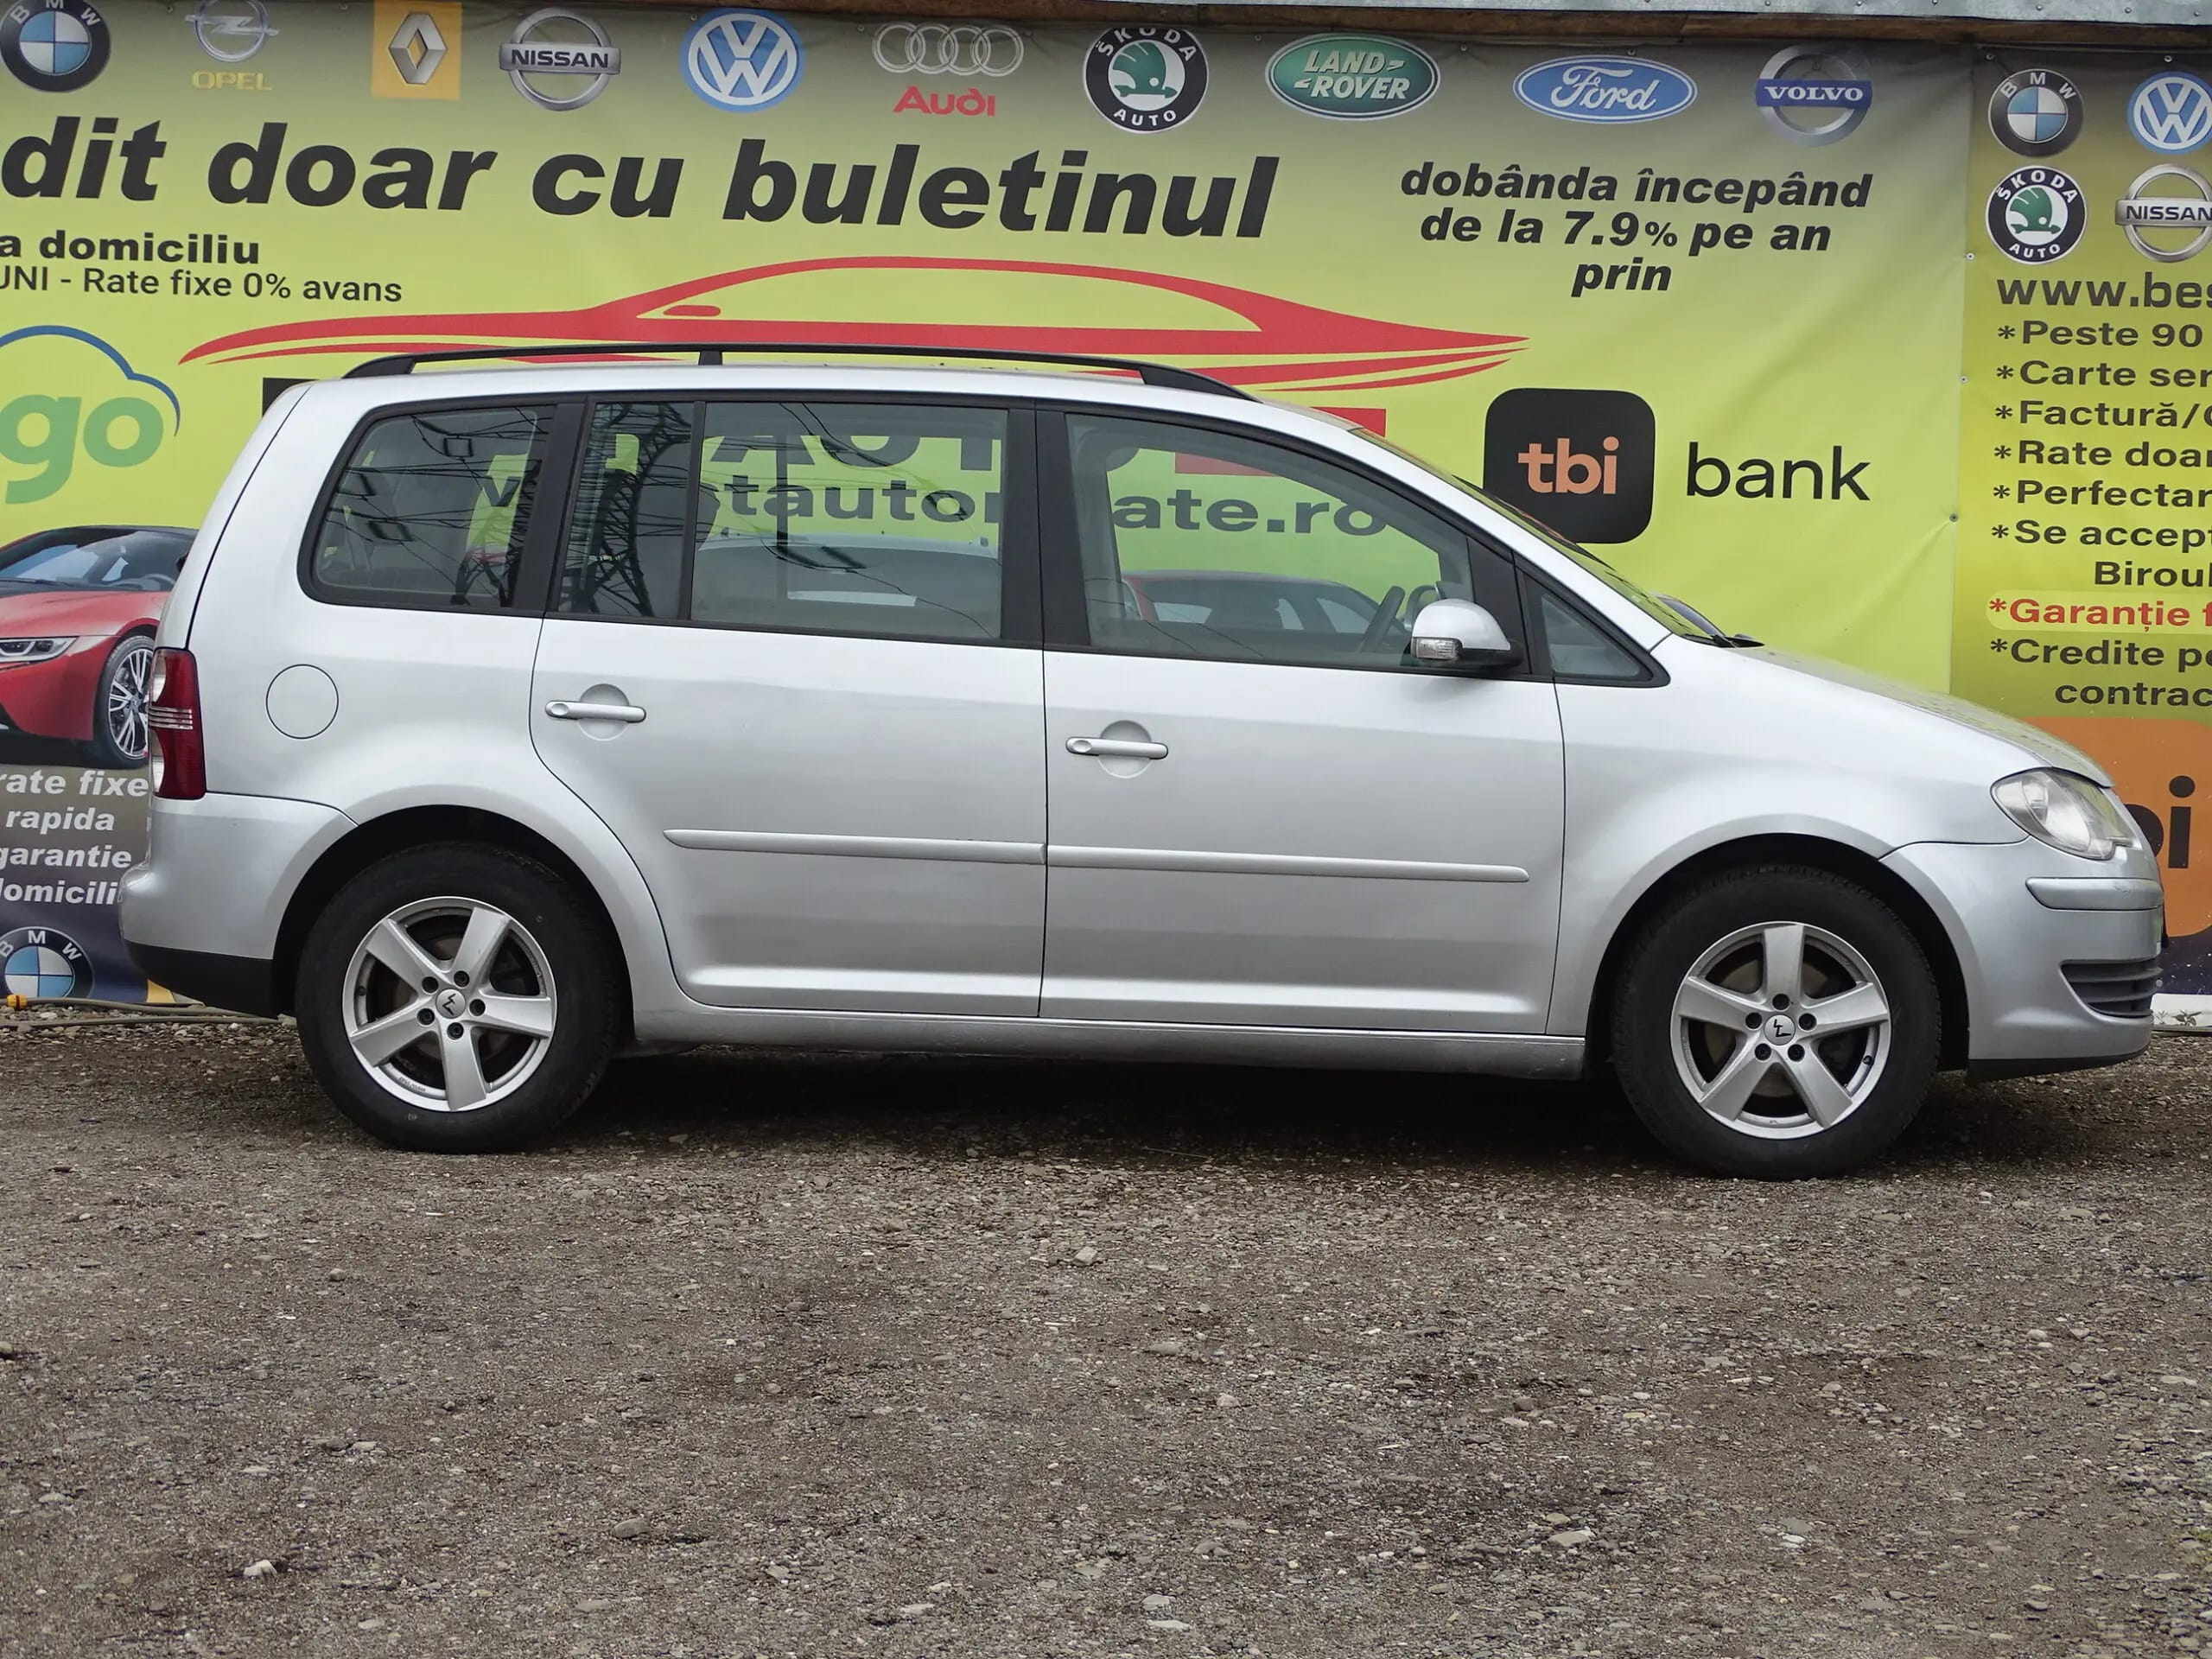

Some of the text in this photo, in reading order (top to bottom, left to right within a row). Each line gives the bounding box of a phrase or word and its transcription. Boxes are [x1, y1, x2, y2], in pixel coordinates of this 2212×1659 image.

[10, 0, 100, 26] BMW
[511, 49, 609, 69] NISSAN
[192, 71, 272, 91] OPEL
[1550, 65, 1661, 111] Ford
[1765, 86, 1864, 102] VOLVO
[2000, 72, 2076, 100] BMW
[893, 86, 995, 117] Audi
[1114, 109, 1176, 126] AUTO
[2, 116, 1280, 238] dit doar cu buletinul
[1401, 162, 1873, 213] dobânda începând
[1996, 169, 2078, 204] ŠKODA
[2126, 205, 2212, 221] NISSAN
[1421, 207, 1481, 241] de
[1497, 209, 1543, 243] la
[1688, 222, 1753, 257] pe
[1770, 224, 1831, 251] an
[39, 230, 259, 264] domiciliu
[2009, 243, 2061, 257] AUTO
[84, 268, 160, 294] Rate
[170, 270, 232, 296] fixe
[242, 273, 292, 299] 0%
[302, 276, 403, 302] avans
[1571, 257, 1672, 297] prin
[2152, 323, 2202, 347] 90
[1517, 437, 1618, 494] tbi
[1686, 442, 1871, 500] bank
[2080, 525, 2212, 553] accep
[79, 770, 149, 797] fixe
[5, 807, 116, 835] rapida
